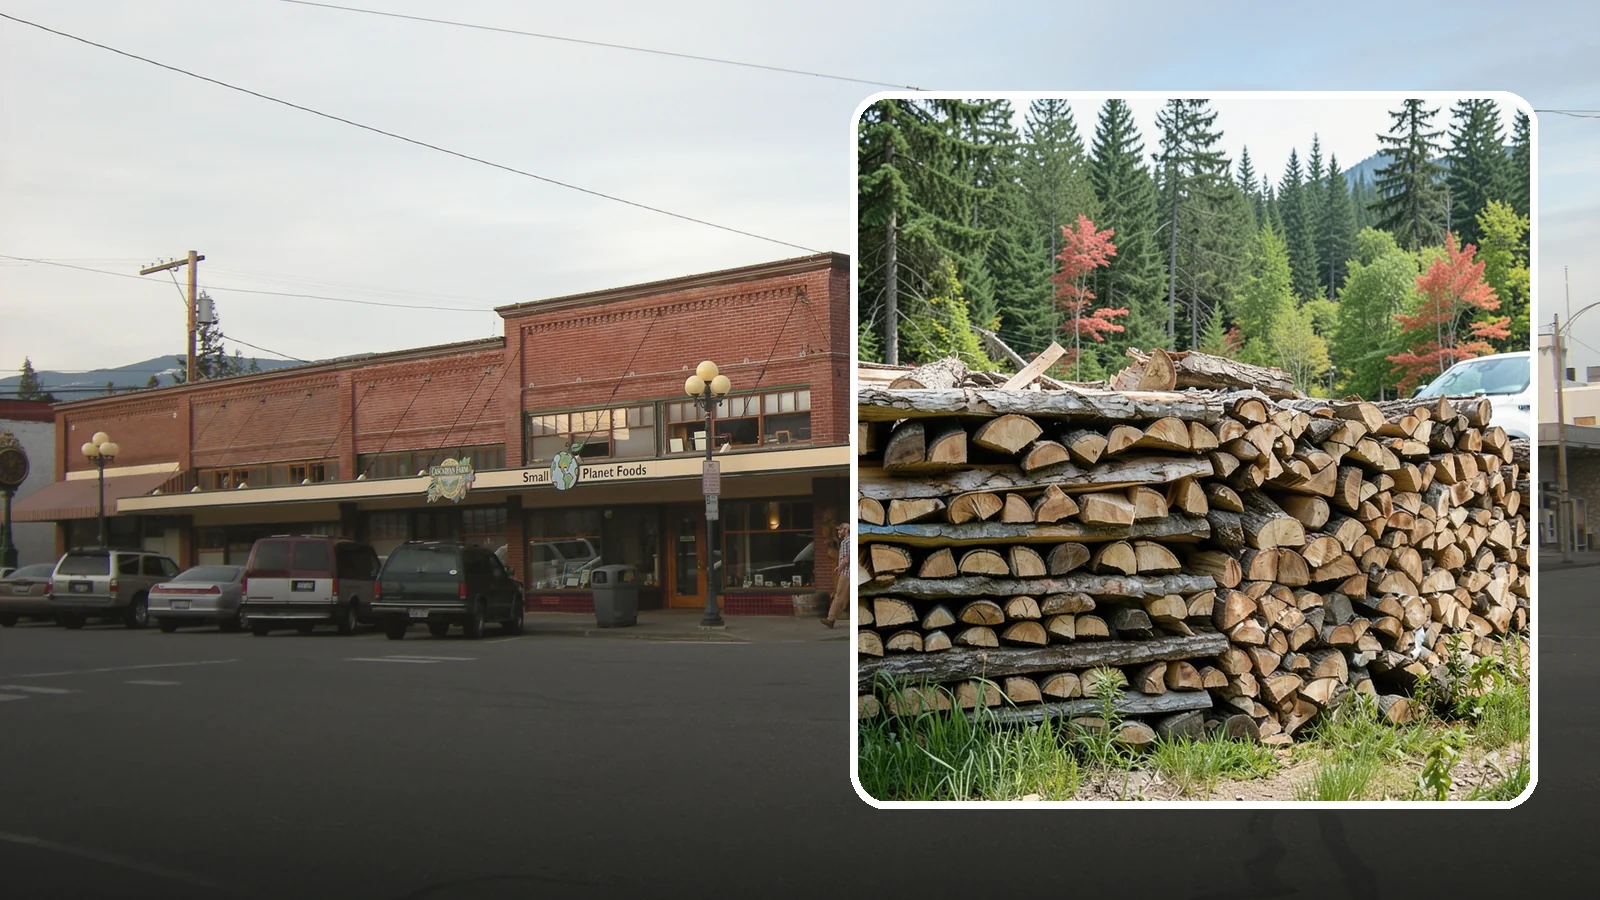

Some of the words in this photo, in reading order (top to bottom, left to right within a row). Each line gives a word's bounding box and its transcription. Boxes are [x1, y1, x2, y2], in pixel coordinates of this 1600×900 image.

[523, 471, 549, 483] Small
[582, 468, 614, 479] Planet
[616, 464, 647, 477] Foods
